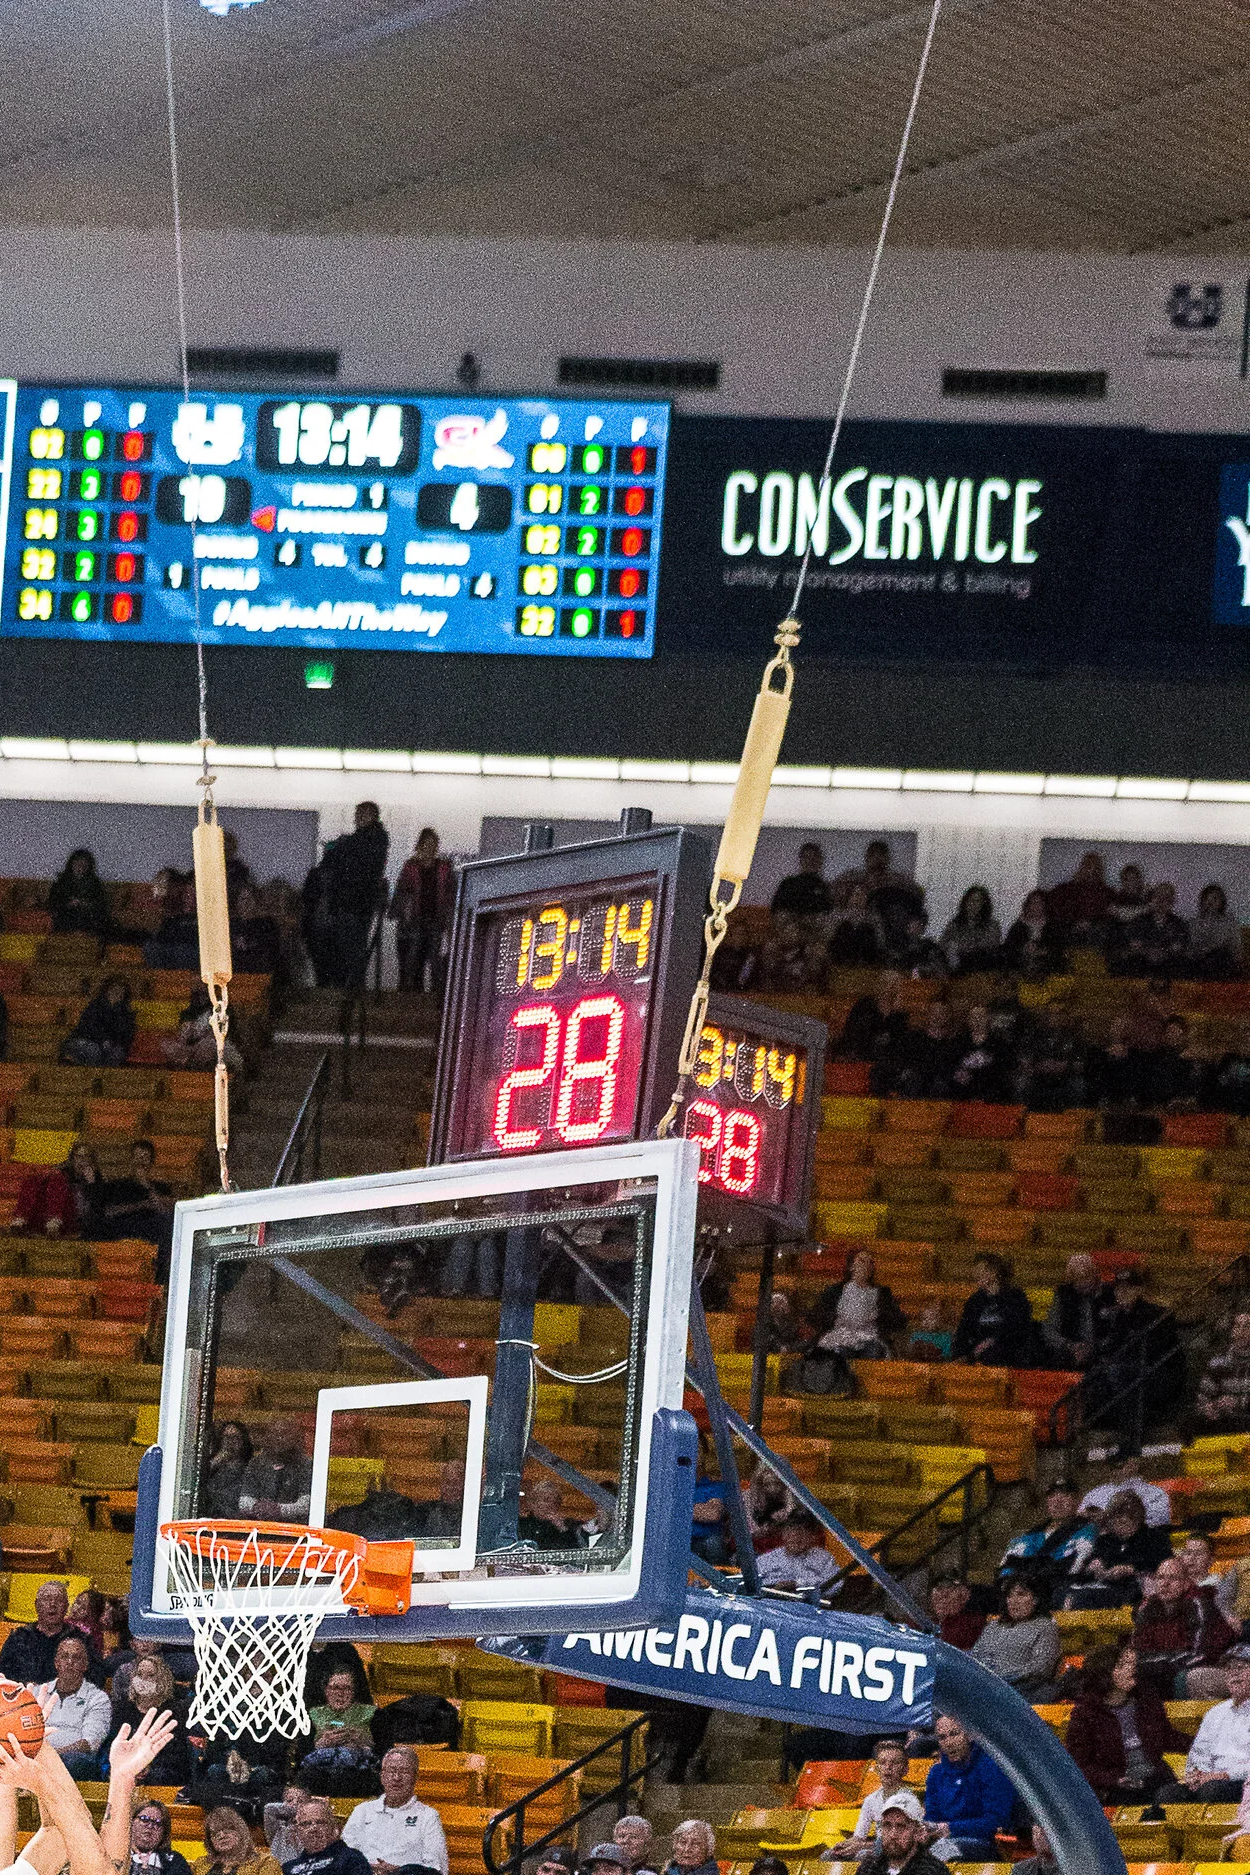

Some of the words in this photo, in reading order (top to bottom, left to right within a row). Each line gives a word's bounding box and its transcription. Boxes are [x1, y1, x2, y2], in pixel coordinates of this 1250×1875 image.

[273, 402, 403, 467] 13:14
[722, 466, 1043, 566] CONSERVICE
[515, 900, 654, 991] 13:14
[494, 993, 626, 1152] 28
[685, 1099, 760, 1194] 28
[790, 1636, 927, 1705] FIRST
